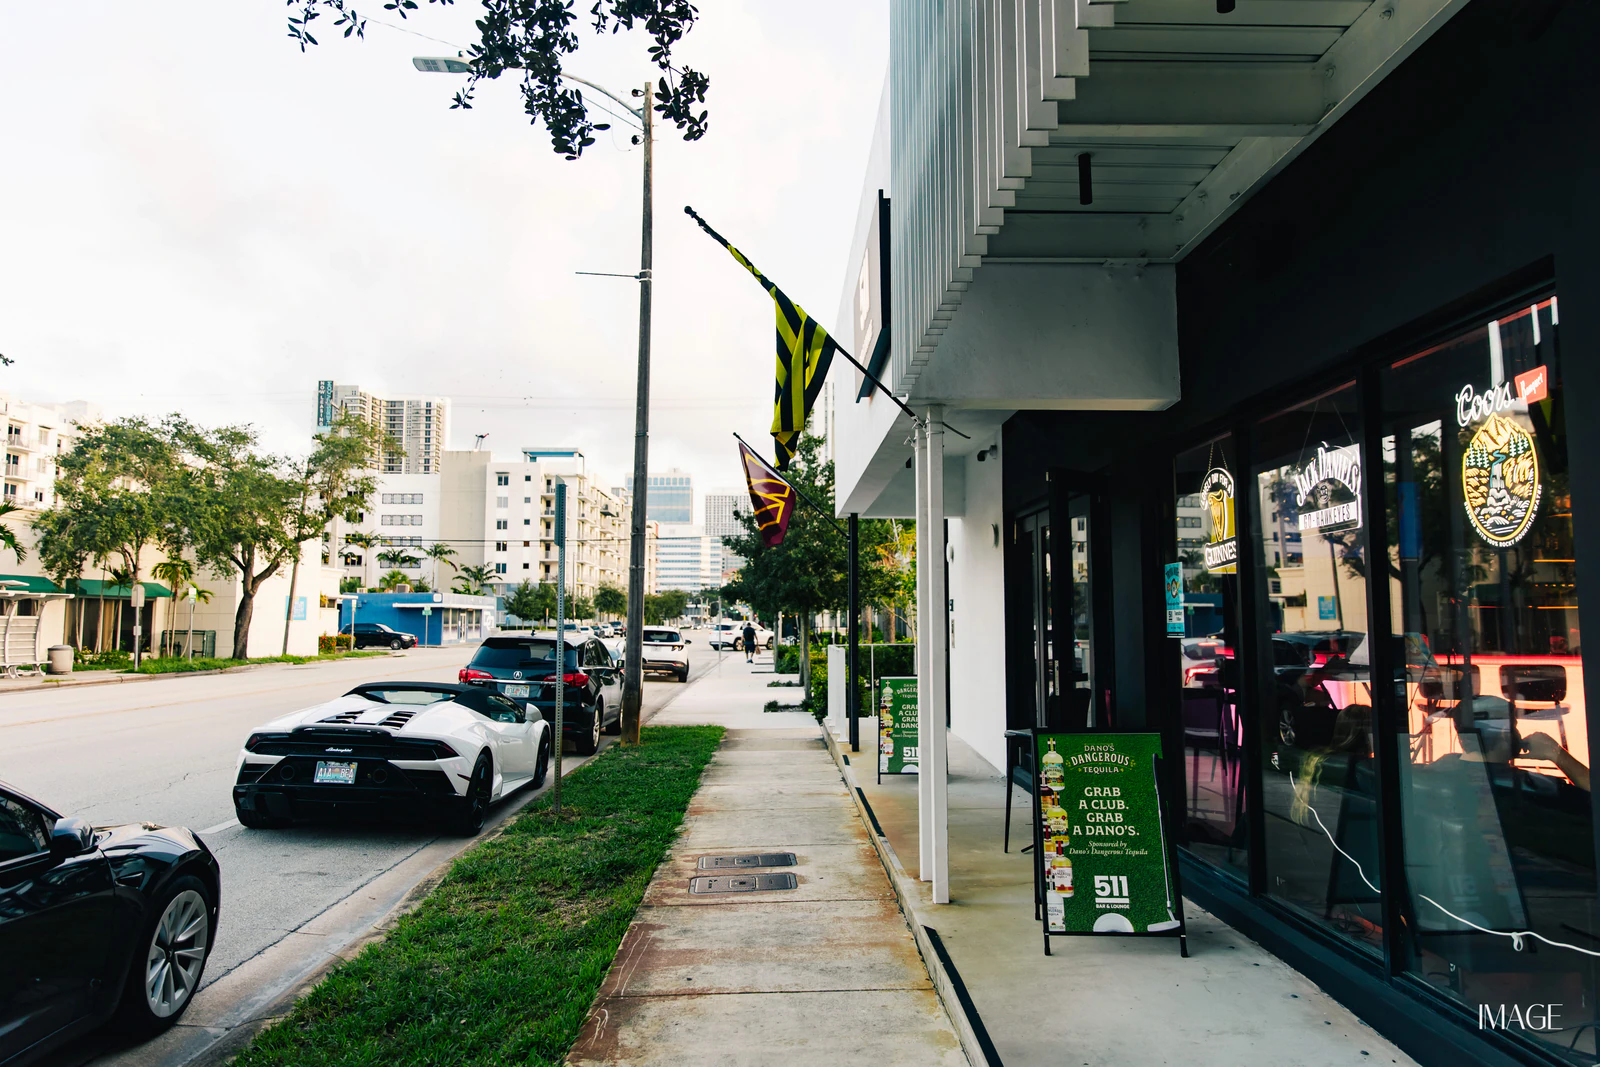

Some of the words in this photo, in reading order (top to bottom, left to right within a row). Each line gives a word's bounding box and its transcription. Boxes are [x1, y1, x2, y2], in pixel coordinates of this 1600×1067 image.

[1455, 384, 1514, 427] Coors
[1520, 372, 1544, 400] Banquet
[1295, 458, 1319, 507] JACK
[1318, 446, 1360, 493] DANIEL'S
[1205, 540, 1237, 566] GUINNES
[1071, 752, 1130, 766] DANGEROUS
[1083, 766, 1119, 774] TEQUILA
[1084, 787, 1121, 797] GRAB
[1078, 799, 1088, 809] A
[1091, 799, 1129, 810] CLUB.
[1086, 812, 1124, 822] GRAB
[1072, 825, 1082, 836] A
[1085, 825, 1140, 836] DANO'S.
[1088, 841, 1119, 849] Sponsored
[1120, 841, 1127, 849] by
[1091, 848, 1124, 857] Dangerous
[1125, 848, 1148, 857] Tequila
[1094, 875, 1129, 897] 511
